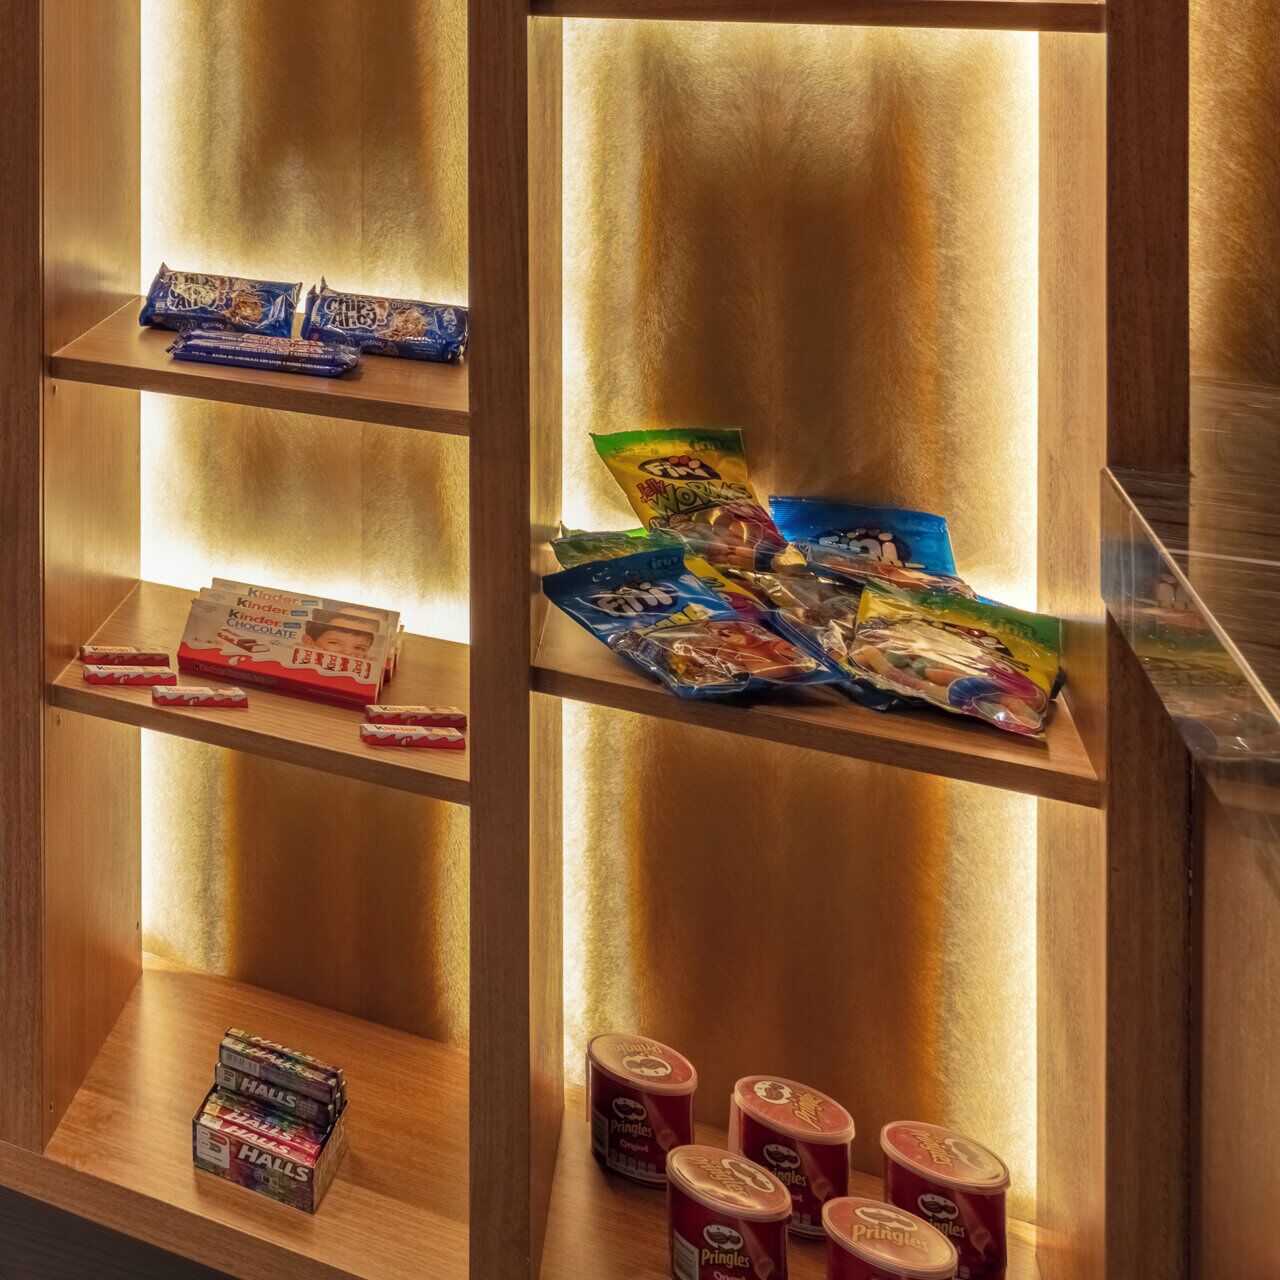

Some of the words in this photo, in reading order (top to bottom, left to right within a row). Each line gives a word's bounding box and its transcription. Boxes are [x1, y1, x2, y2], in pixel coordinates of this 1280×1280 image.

[647, 481, 753, 516] WORMS
[236, 597, 289, 616] Kinder
[247, 587, 299, 605] Kinder
[228, 608, 283, 628] Kinder
[226, 618, 298, 640] CHOCOLATE
[239, 1077, 297, 1109] HALLS
[610, 1118, 653, 1138] Pringles
[224, 1125, 291, 1154] HALLS
[238, 1144, 310, 1182] HALLS
[777, 1168, 808, 1188] ingles
[852, 1223, 930, 1254] Pringles
[701, 1248, 752, 1269] Pringles
